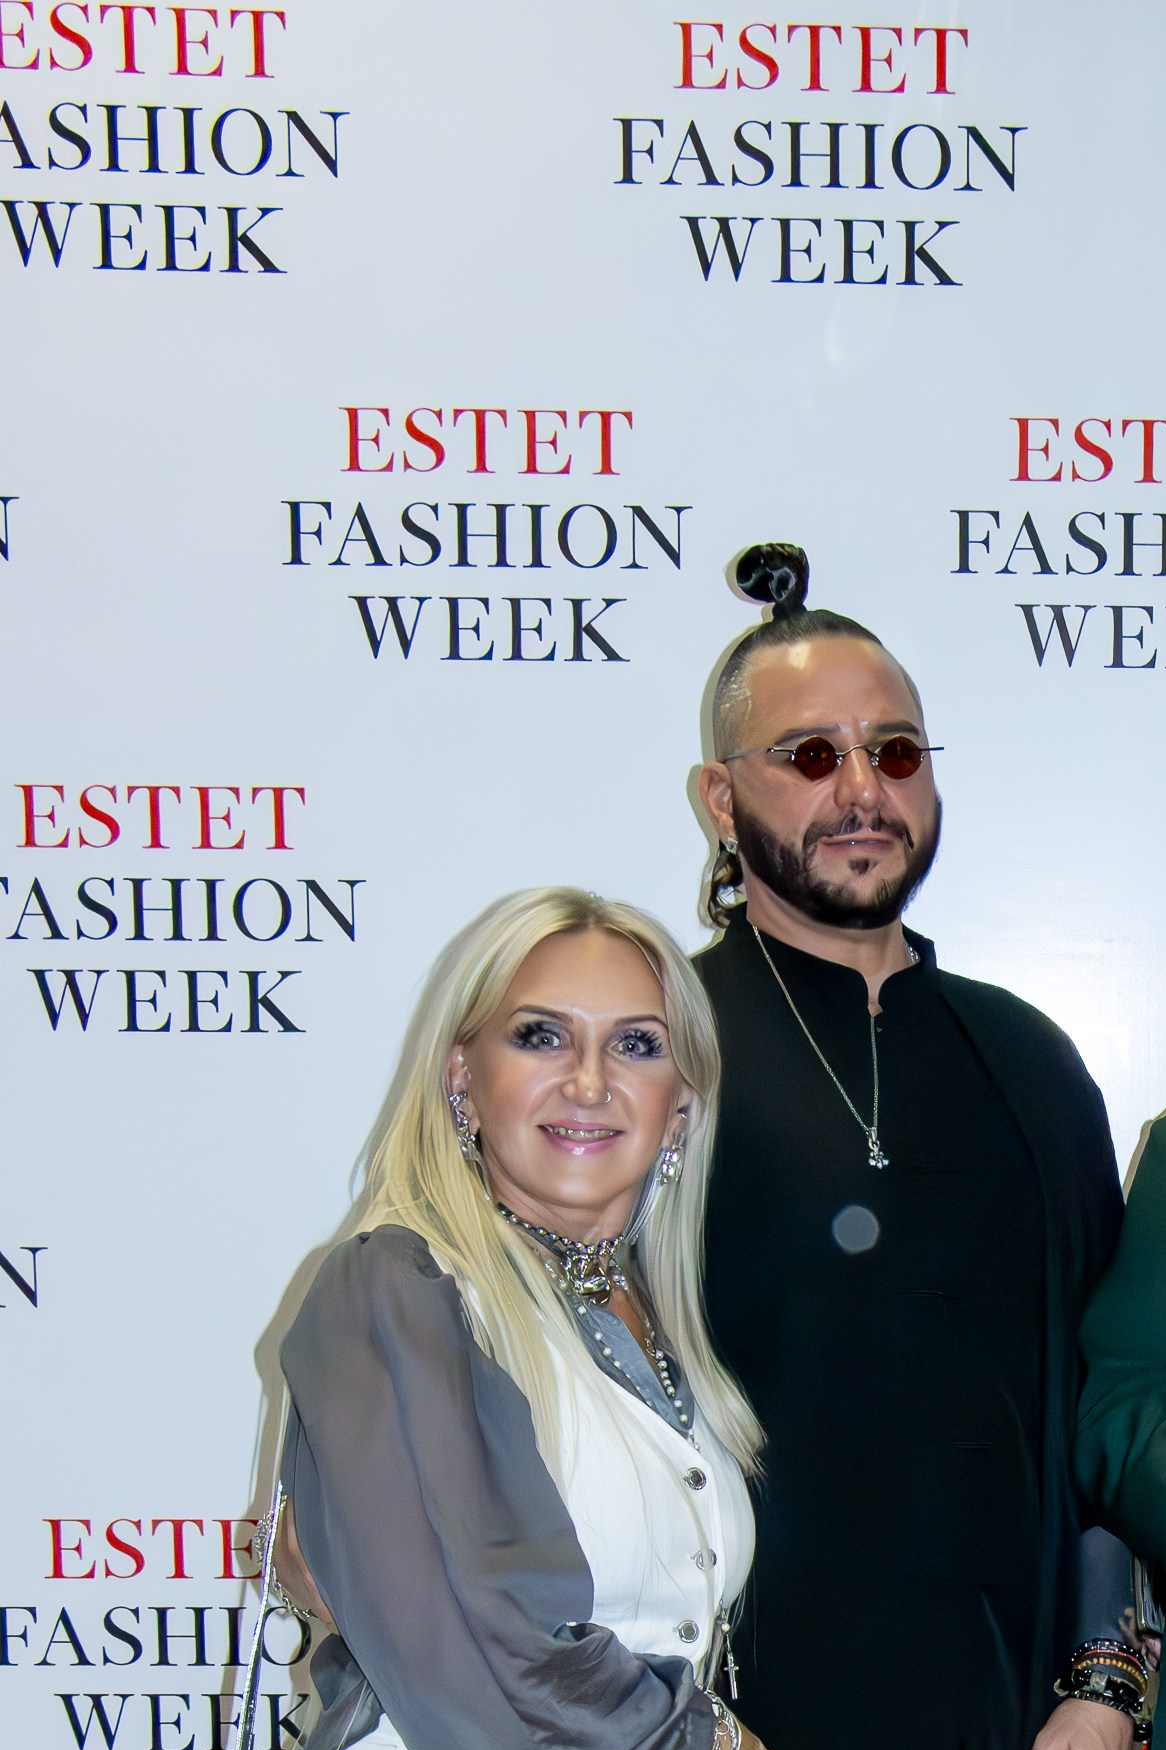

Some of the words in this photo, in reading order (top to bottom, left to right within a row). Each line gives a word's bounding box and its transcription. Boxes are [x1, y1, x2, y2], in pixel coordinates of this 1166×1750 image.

[0, 1, 285, 78] ESTET
[674, 23, 968, 94] ESTET
[0, 101, 350, 178] ASHION
[613, 119, 1028, 191] FASHION
[0, 200, 287, 273] WEEK
[680, 216, 963, 286] WEEK
[340, 408, 632, 475] ESTET
[281, 501, 693, 569] FASHION
[348, 596, 630, 662] WEEK
[15, 785, 305, 849] ESTET
[0, 877, 366, 942] ASHION
[27, 969, 306, 1032] WEEK
[43, 1519, 265, 1580] ESTE
[0, 1606, 311, 1667] FASHIO
